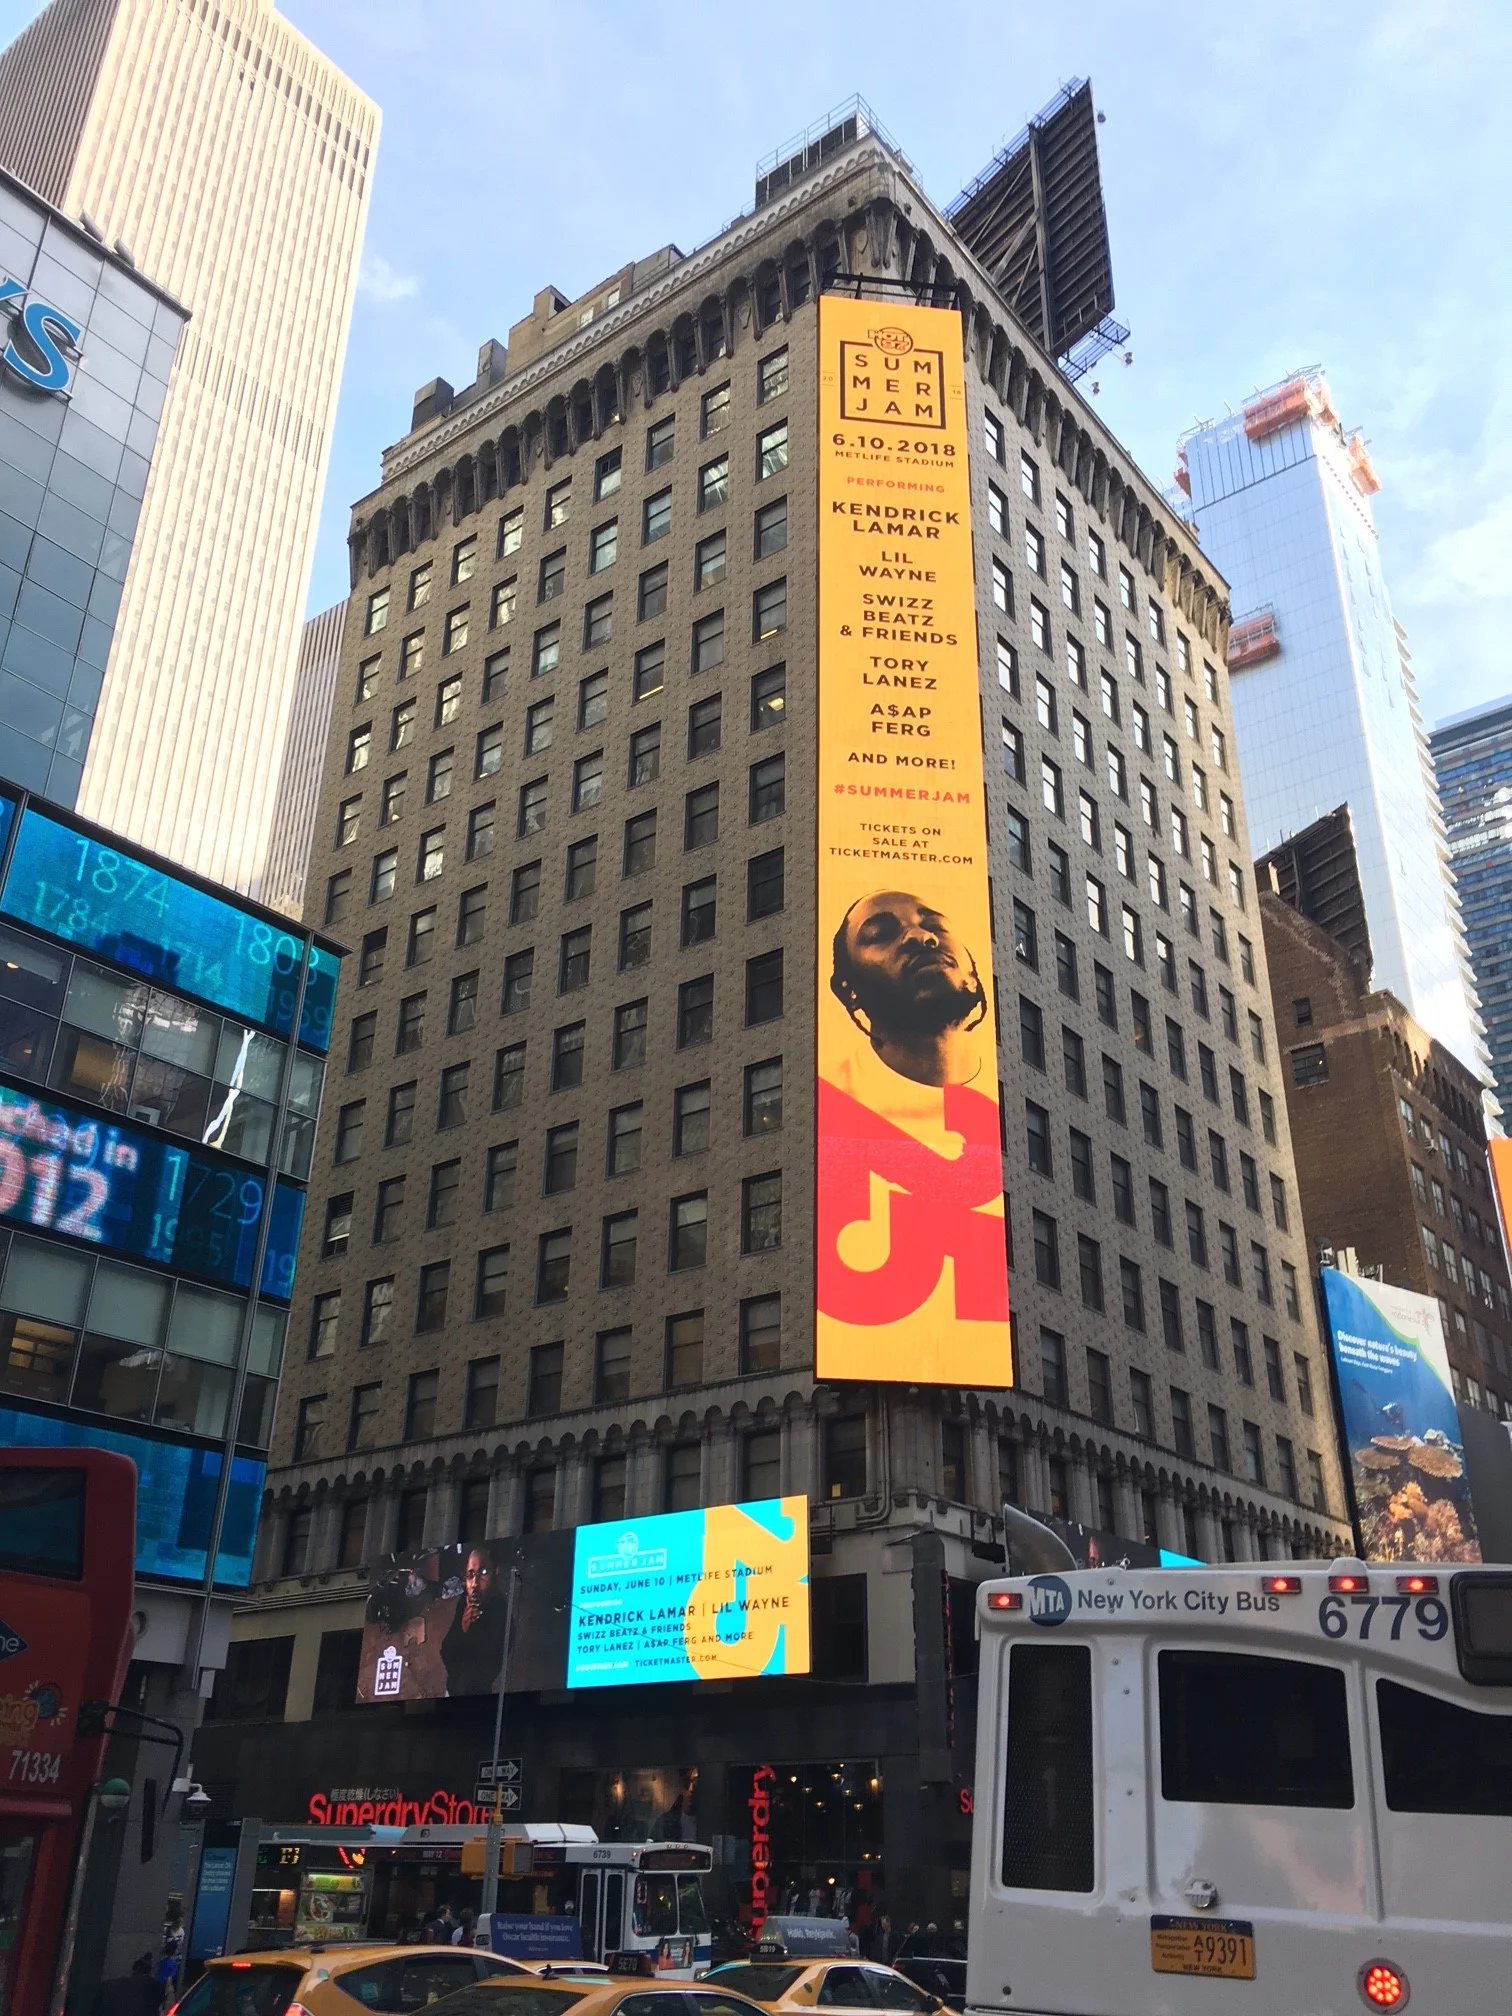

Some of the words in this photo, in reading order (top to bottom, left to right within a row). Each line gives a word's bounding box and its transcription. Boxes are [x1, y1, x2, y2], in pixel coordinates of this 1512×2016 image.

[856, 398, 933, 419] JAM
[832, 433, 957, 457] 6.10.2018
[835, 451, 891, 462] METLIFE
[896, 456, 955, 468] STADIUM
[847, 476, 945, 494] PERFORMING
[832, 501, 960, 525] KENDRICK
[853, 520, 940, 539] LAMAR
[881, 551, 913, 564] LIL
[859, 565, 937, 583] WAYNE
[862, 593, 934, 610] SWIZZ
[863, 610, 934, 627] BEATZ
[840, 624, 852, 637] &
[862, 627, 958, 646] FRIENDS
[870, 656, 929, 672] TORY
[863, 673, 937, 690] LANEZ
[870, 703, 932, 718] A$AP
[872, 721, 931, 737] FERG
[848, 752, 888, 764] AND
[896, 755, 956, 770] MORE!
[834, 783, 970, 804] #SUMMERJAM
[860, 823, 917, 834] TICKETS
[922, 827, 941, 836] ON
[872, 837, 907, 847] SALE
[912, 840, 929, 848] AT
[829, 847, 973, 865] TICKETMASTER.COM
[74, 839, 169, 918] 1874
[166, 1154, 263, 1225] 1729
[1337, 1330, 1367, 1347] Discover
[1367, 1340, 1394, 1354] nature's
[1394, 1344, 1418, 1362] beauty
[1338, 1341, 1367, 1358] beneath
[1367, 1350, 1379, 1362] the
[1379, 1355, 1400, 1367] waves
[580, 1582, 621, 1595] SUNDAY,
[625, 1578, 650, 1590] JUNE
[655, 1576, 665, 1587] 10
[677, 1571, 720, 1584] METLIFE
[725, 1565, 773, 1578] STADIUM
[1028, 1585, 1066, 1617] MTA
[1078, 1589, 1124, 1611] New
[1129, 1589, 1179, 1611] York
[1184, 1589, 1229, 1616] City
[1236, 1590, 1280, 1613] Bus
[579, 1610, 644, 1627] KENDRICK
[650, 1605, 695, 1620] LAMAR
[712, 1602, 732, 1614] LIL
[739, 1596, 790, 1611] WAYNE
[1318, 1596, 1449, 1643] 6779
[577, 1630, 606, 1641] SWIZZ
[610, 1627, 638, 1638] BEATZ
[642, 1626, 648, 1635] &
[651, 1623, 691, 1634] FRIENDS
[577, 1644, 600, 1654] TORY
[604, 1641, 634, 1652] LANEZ
[644, 1638, 669, 1649] A$AP
[673, 1636, 697, 1646] FERG
[702, 1634, 721, 1643] AND
[726, 1631, 753, 1641] MORE
[635, 1654, 717, 1667] TICKETMASTER.COM
[9, 1749, 61, 1784] 71334
[480, 1791, 495, 1801] ONE
[593, 1850, 611, 1859] 6739
